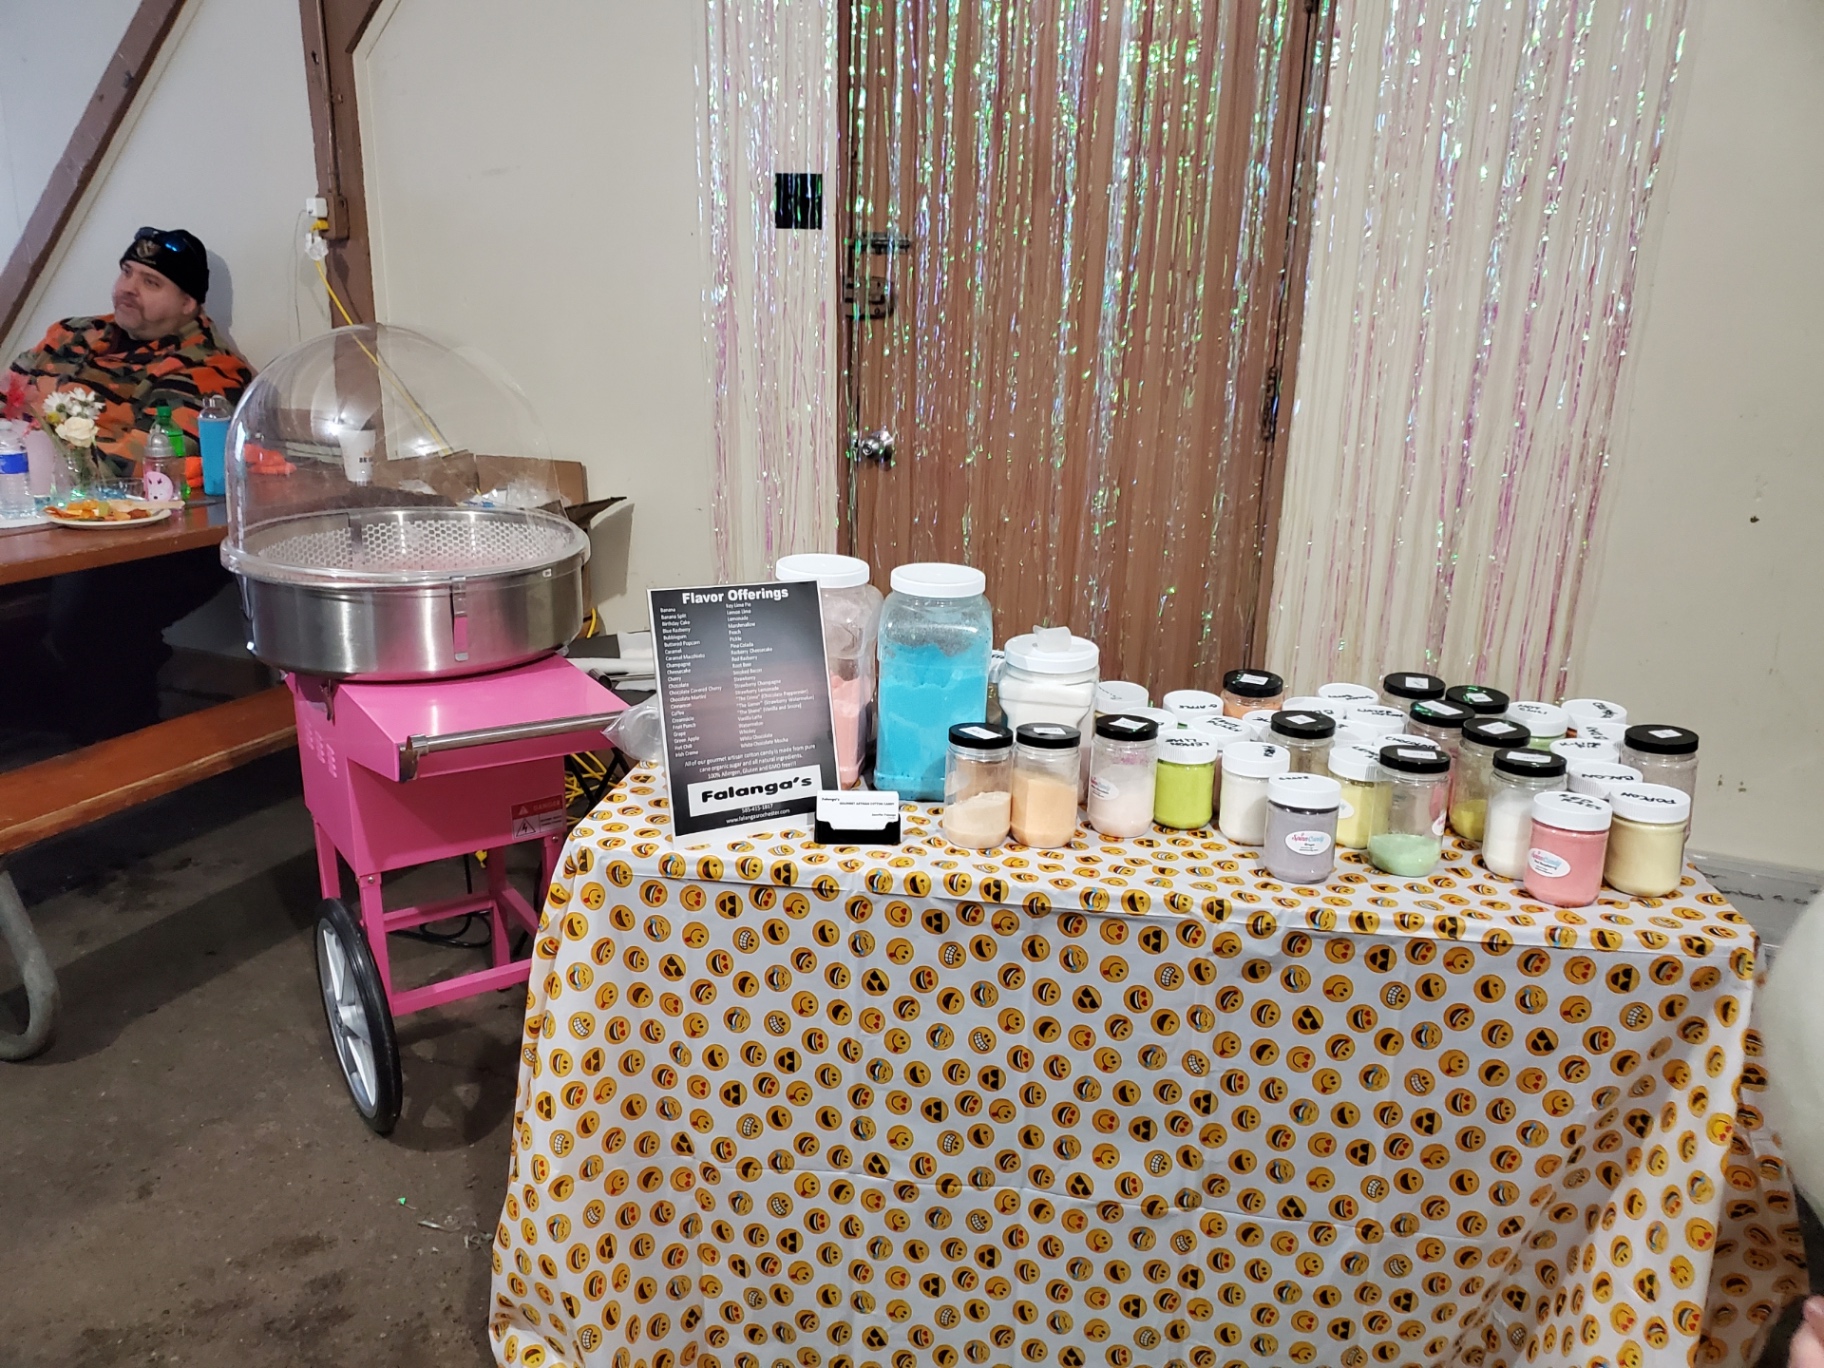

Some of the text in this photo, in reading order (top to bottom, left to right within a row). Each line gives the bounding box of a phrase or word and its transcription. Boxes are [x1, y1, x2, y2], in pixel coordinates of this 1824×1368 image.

[682, 588, 788, 604] Flavor Offerings
[707, 757, 726, 765] gourmet
[711, 763, 730, 771] organic
[758, 755, 775, 764] natural
[776, 753, 802, 762] ingredients.
[702, 776, 812, 802] Falanga's
[726, 808, 790, 824] www.falangasrochester.com
